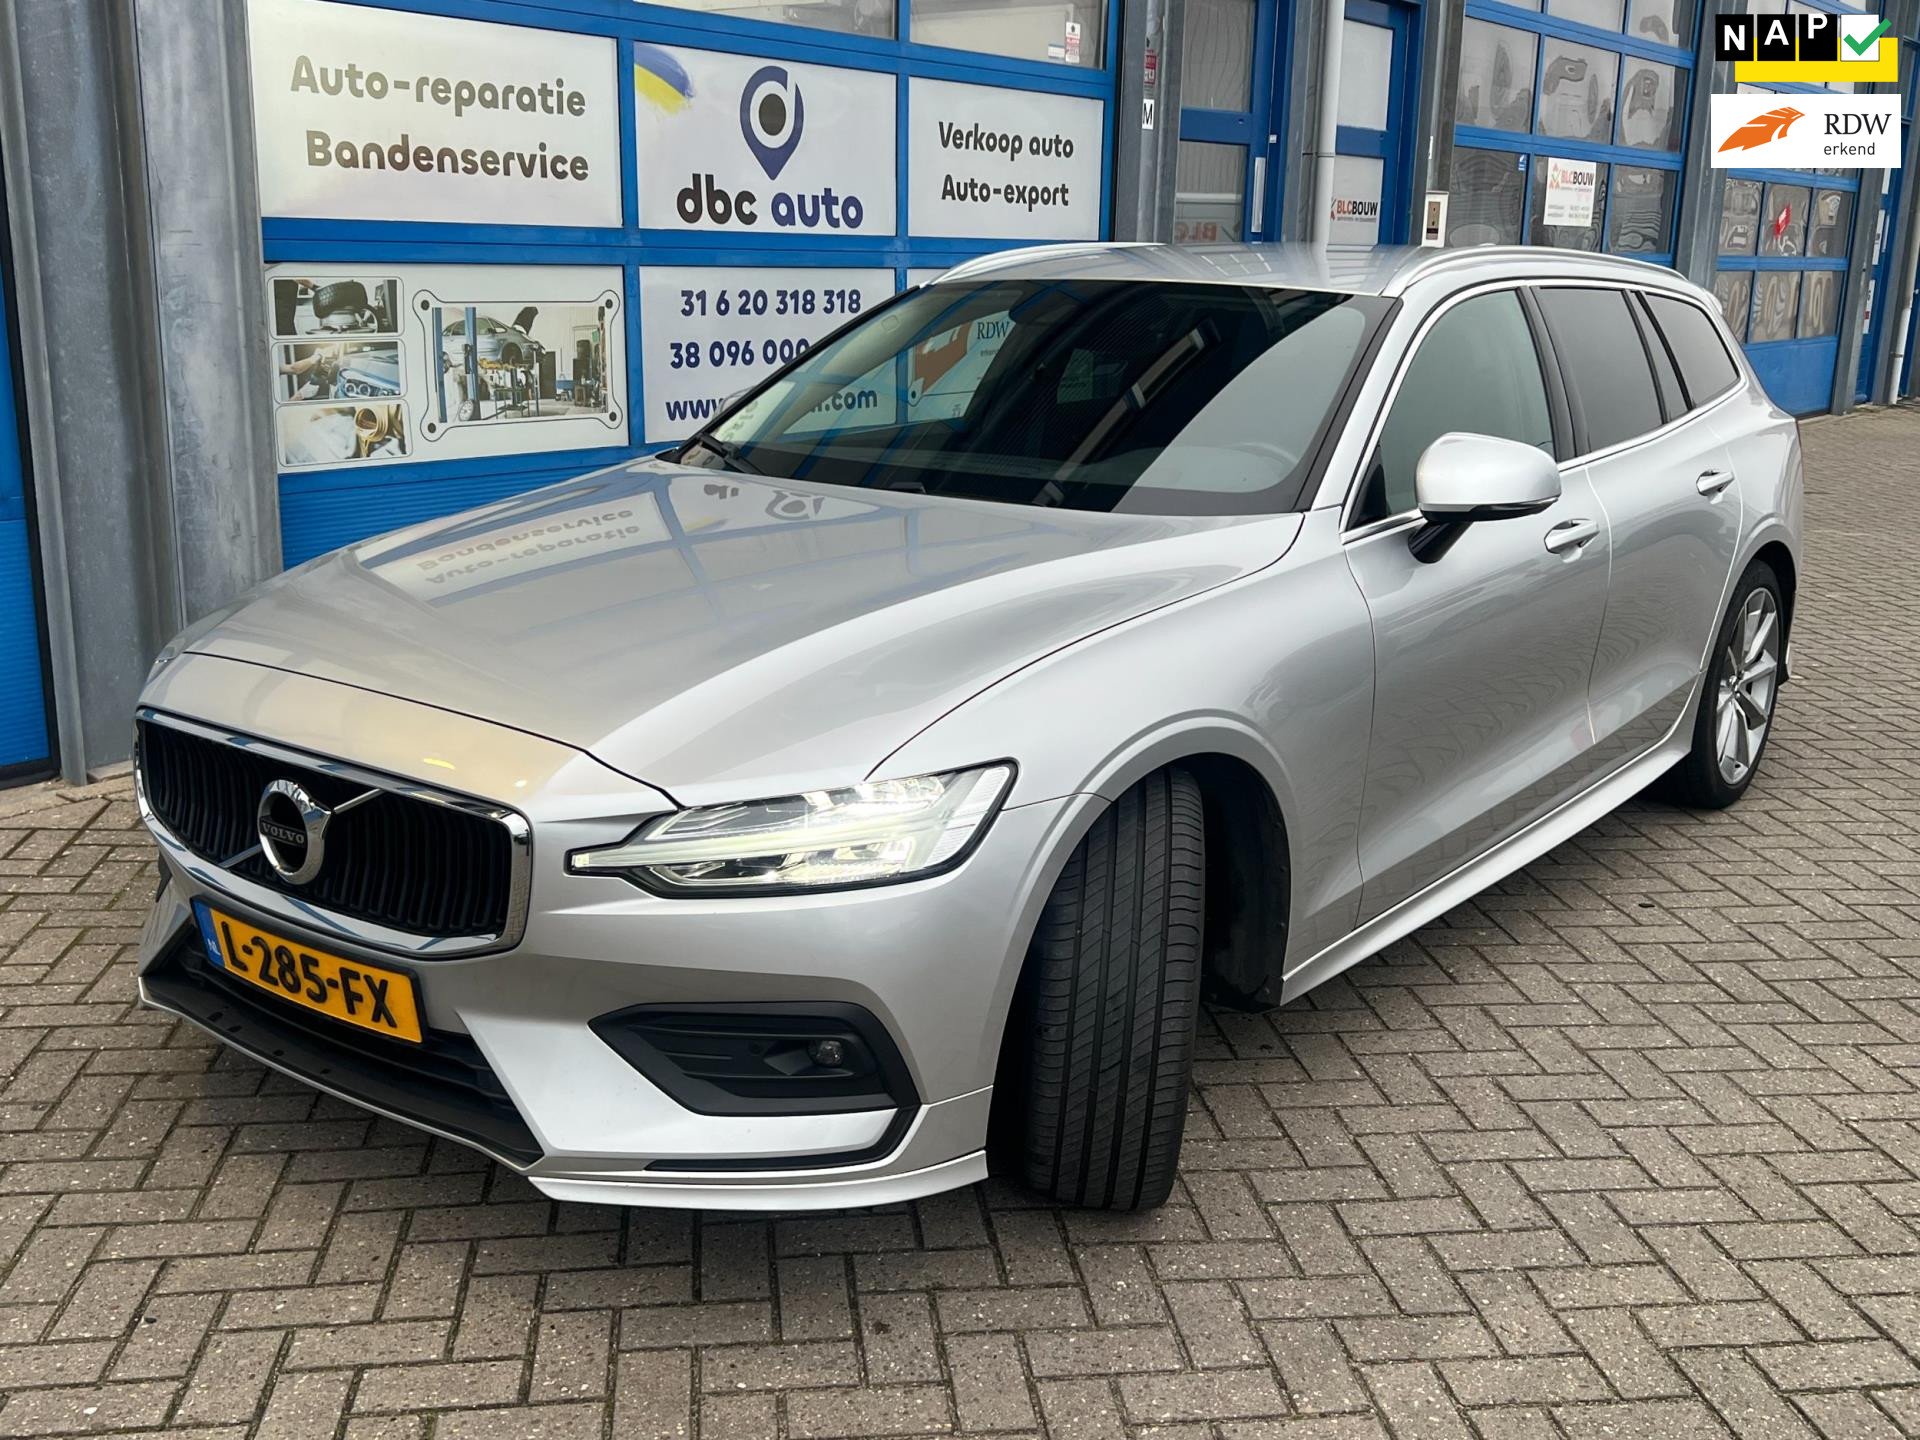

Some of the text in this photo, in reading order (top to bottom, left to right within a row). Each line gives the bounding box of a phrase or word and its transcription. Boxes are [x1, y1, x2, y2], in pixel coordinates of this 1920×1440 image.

[290, 54, 586, 118] Auto-reparatie
[1142, 102, 1153, 125] M
[305, 129, 590, 181] Bandenservice
[939, 121, 1074, 161] Verkoop auto
[676, 173, 864, 229] dbc auto
[941, 173, 1069, 212] Auto-export
[1336, 199, 1379, 216] BLCBOUW
[680, 288, 862, 317] 31 6 20 318 318
[977, 321, 1009, 339] RDW
[669, 342, 700, 369] 38
[709, 340, 755, 368] 096
[261, 821, 305, 844] VOLVO
[207, 937, 221, 956] NL
[220, 921, 398, 1029] L-285-FX
